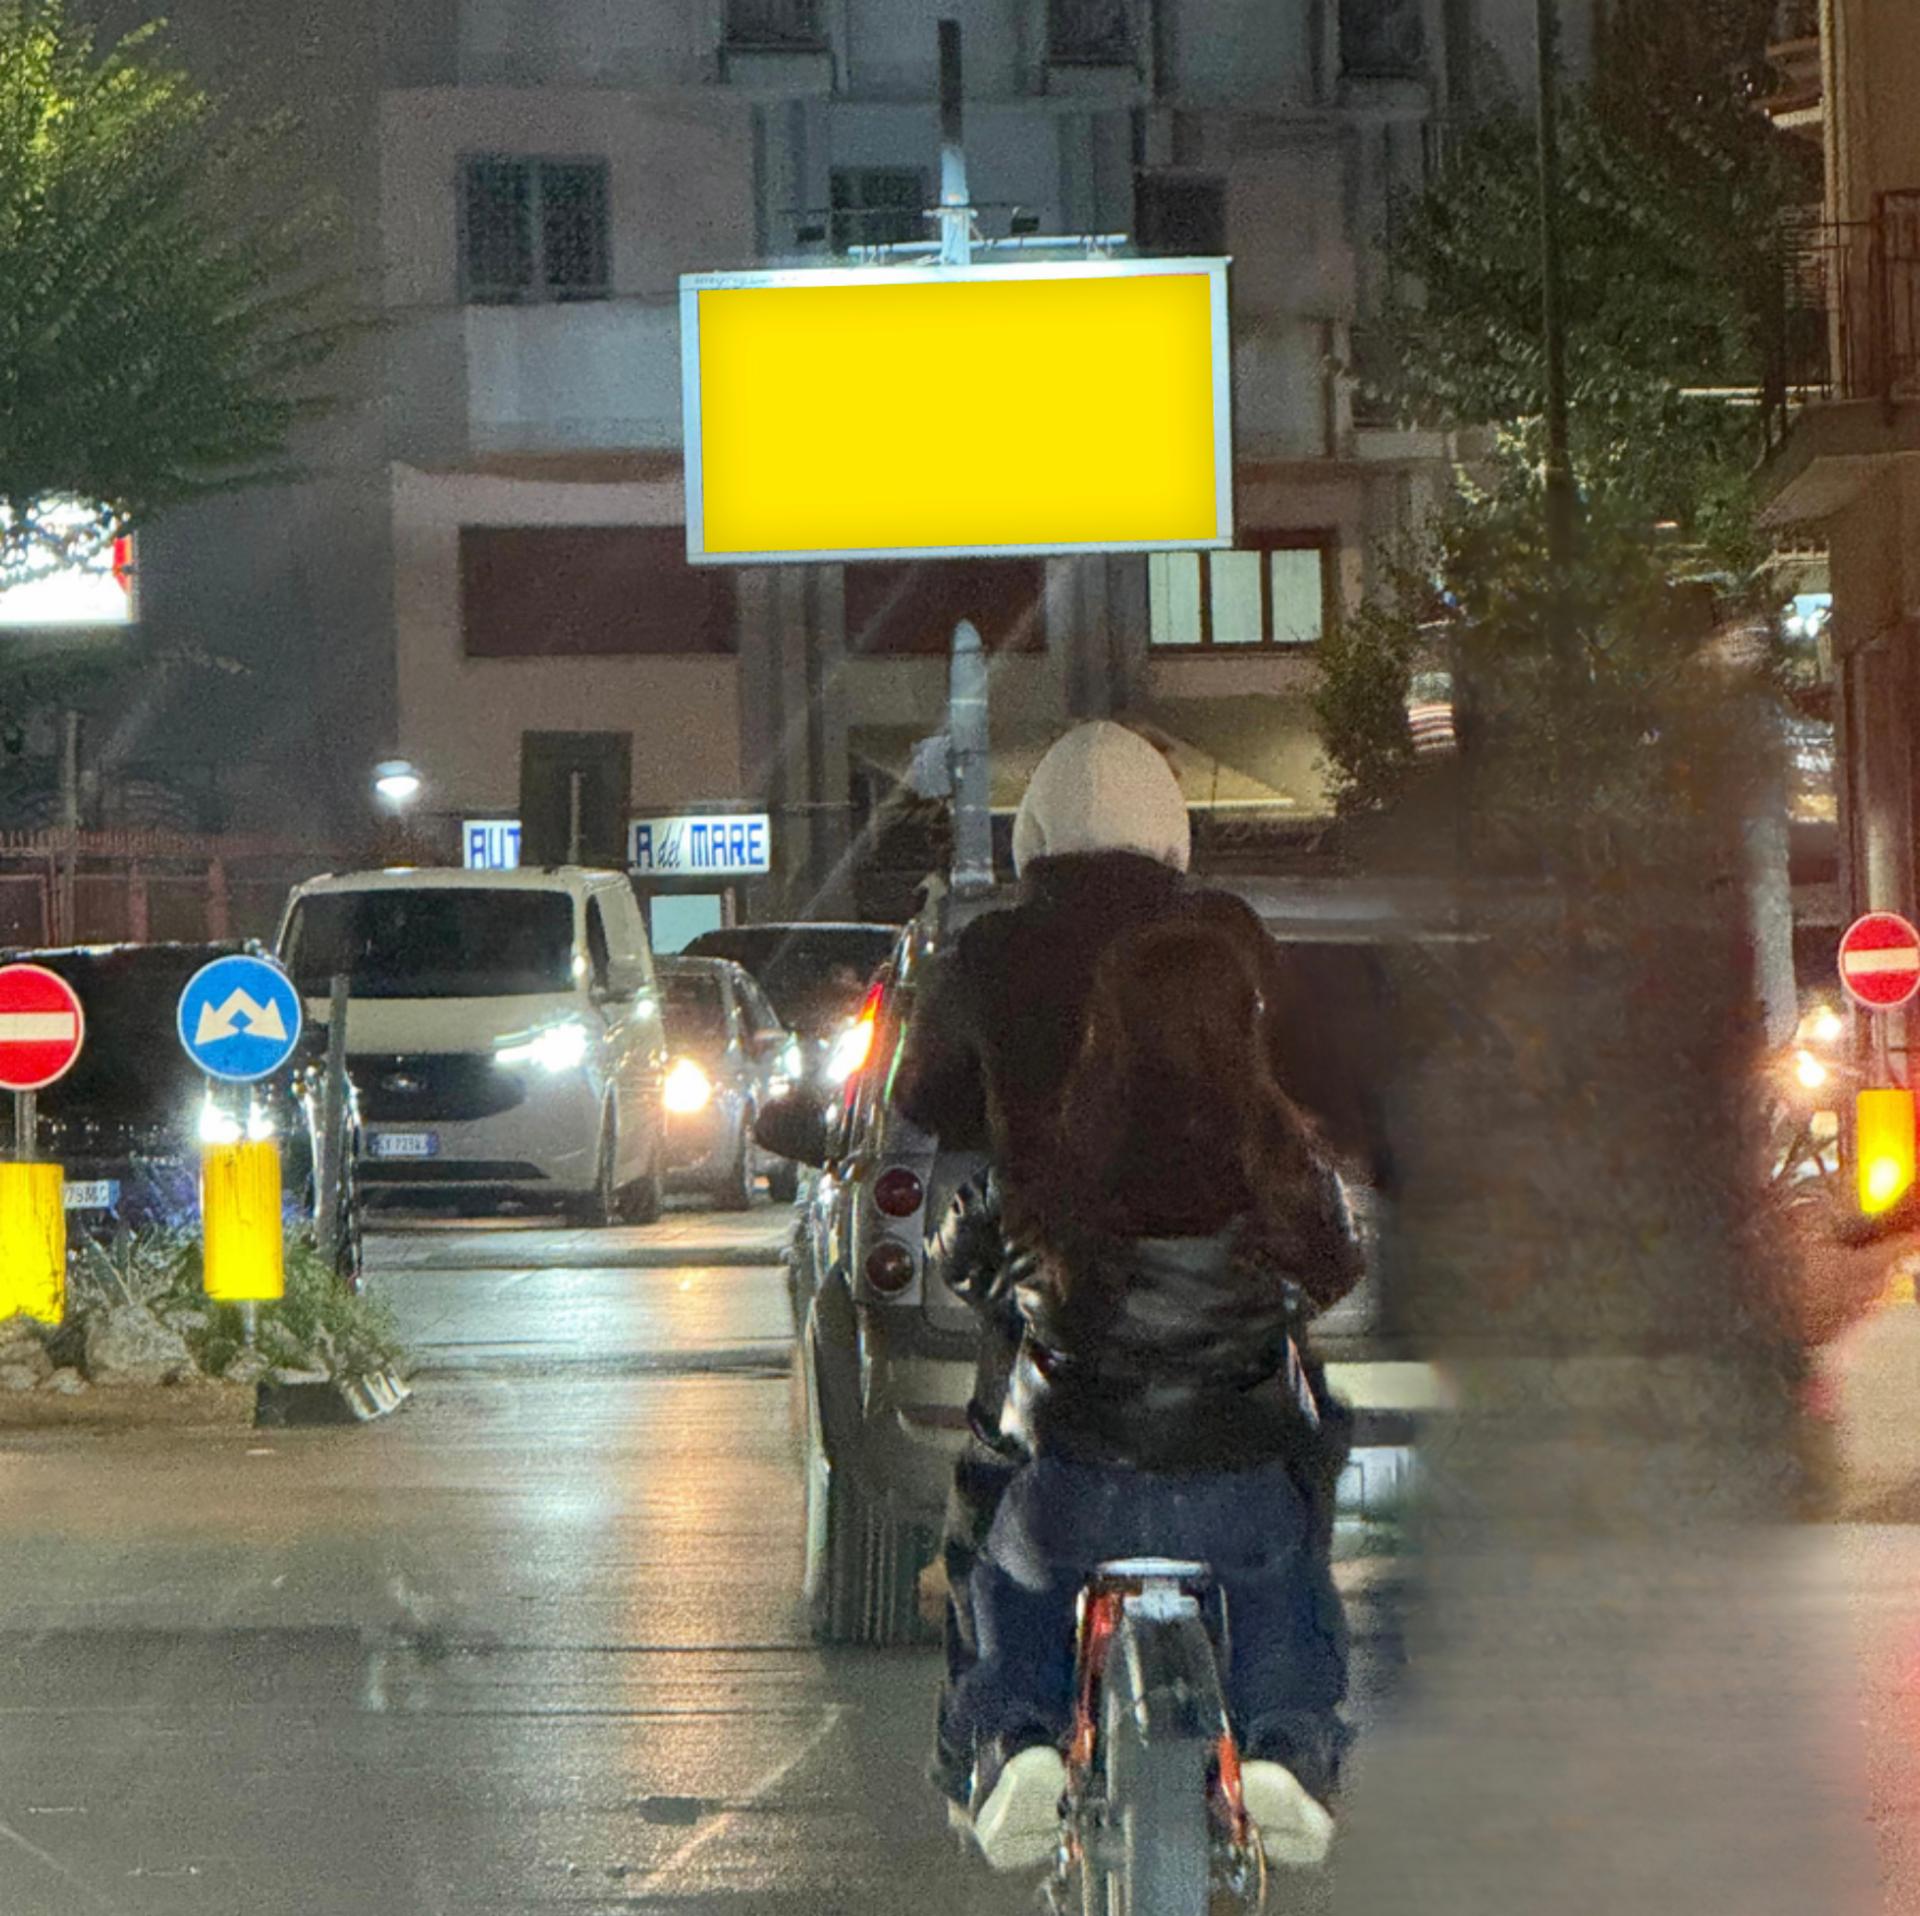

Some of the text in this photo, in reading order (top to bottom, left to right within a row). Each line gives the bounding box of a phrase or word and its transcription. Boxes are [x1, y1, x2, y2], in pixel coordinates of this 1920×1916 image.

[470, 822, 764, 869] AUT A del MARE
